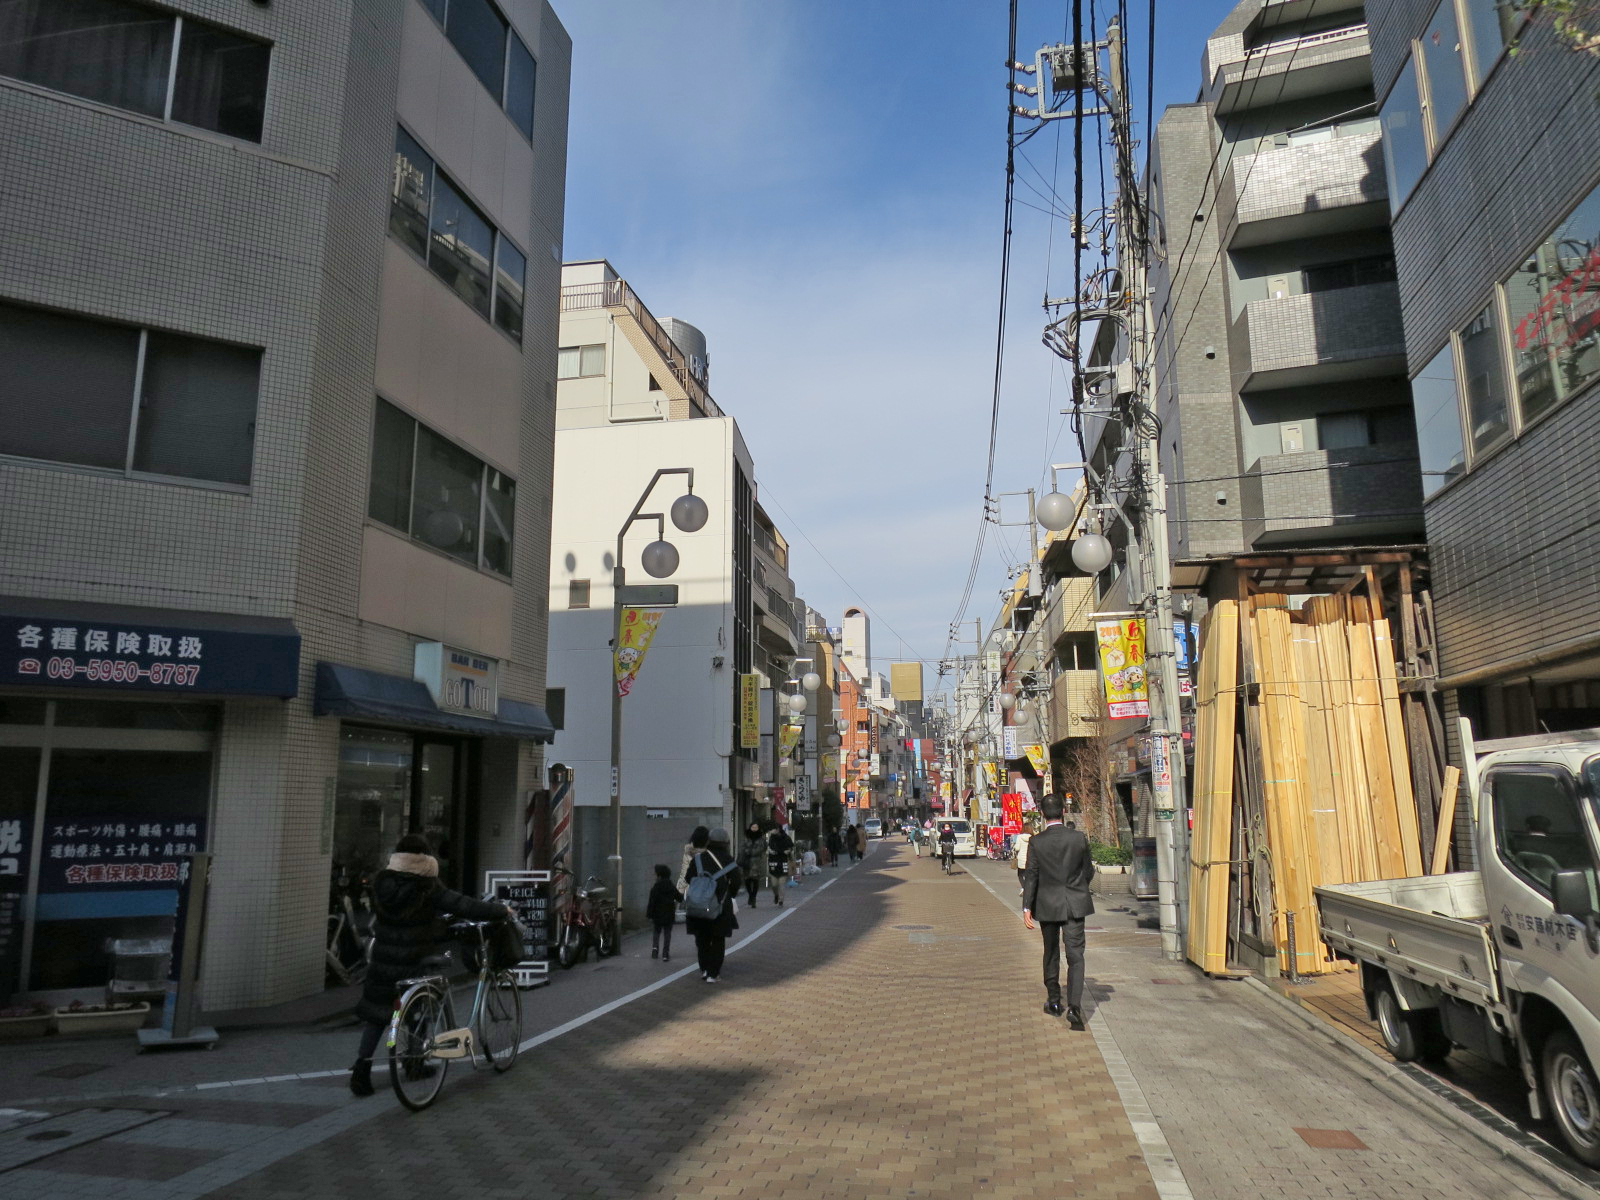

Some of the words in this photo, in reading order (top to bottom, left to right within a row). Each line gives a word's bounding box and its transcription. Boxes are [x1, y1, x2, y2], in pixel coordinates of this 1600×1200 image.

[17, 624, 203, 659] 各種保険取扱
[46, 656, 201, 686] 03-5950-8787
[445, 677, 489, 712] GOTOH
[65, 862, 178, 885] 各種保険取扱
